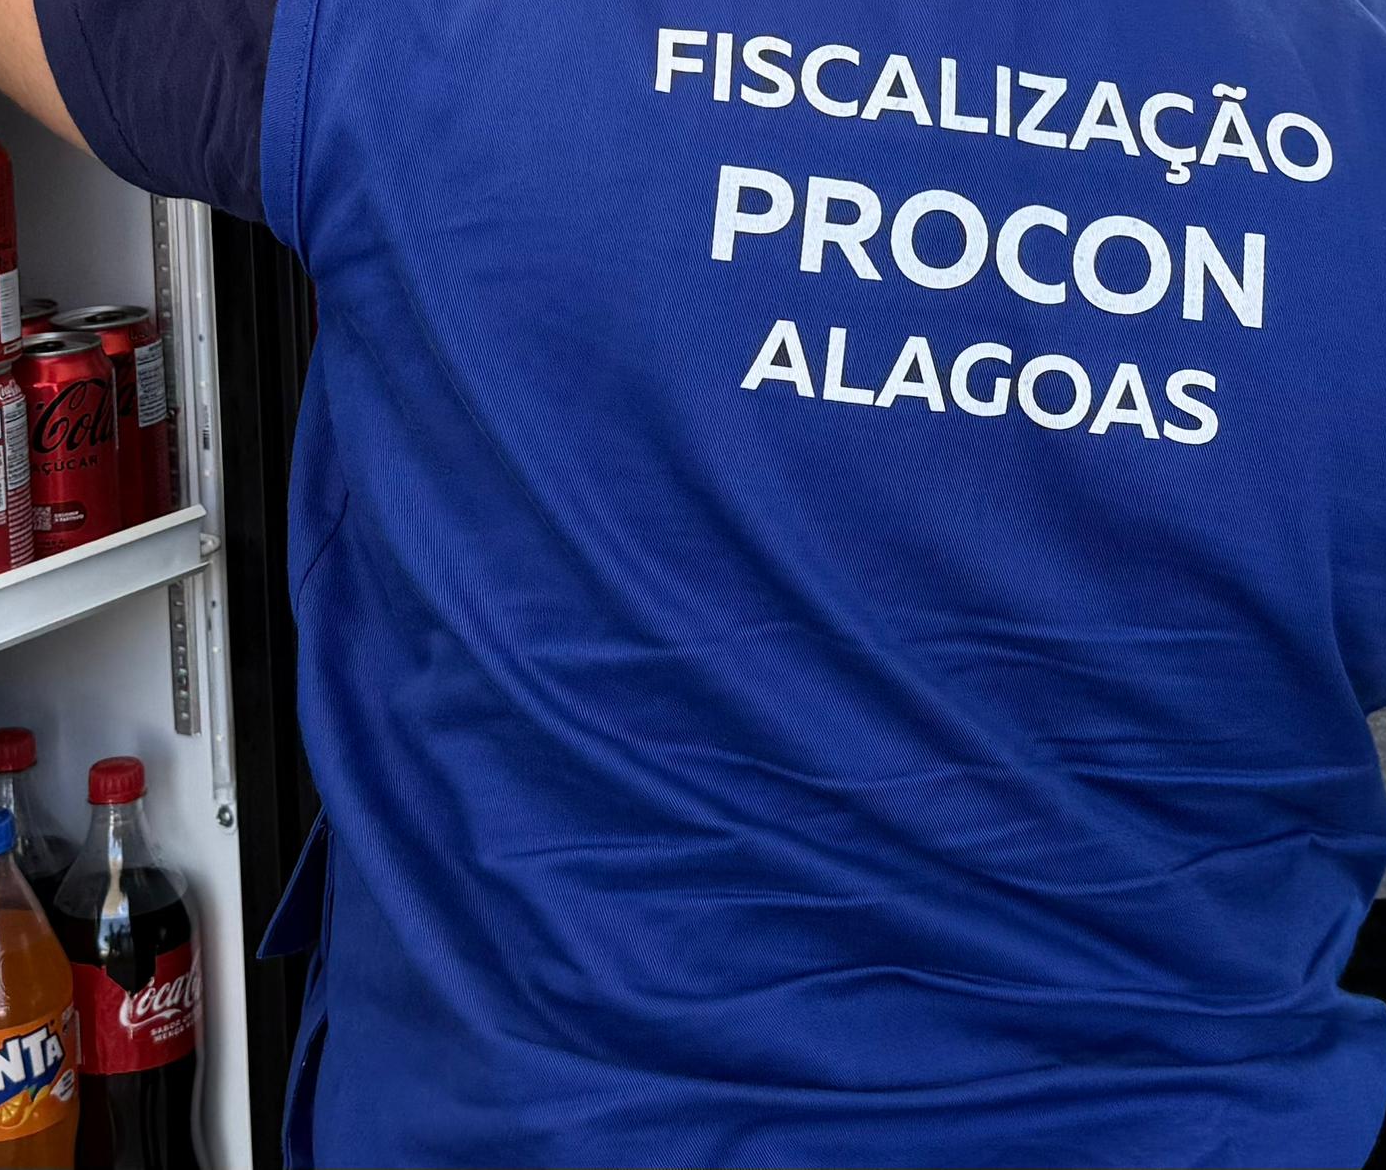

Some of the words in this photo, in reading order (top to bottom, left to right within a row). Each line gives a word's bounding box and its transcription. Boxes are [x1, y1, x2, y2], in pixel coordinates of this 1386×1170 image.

[654, 28, 1333, 184] FISCALIZAÇÃO
[711, 164, 1266, 329] PROCON
[740, 319, 1217, 444] ALAGOAS
